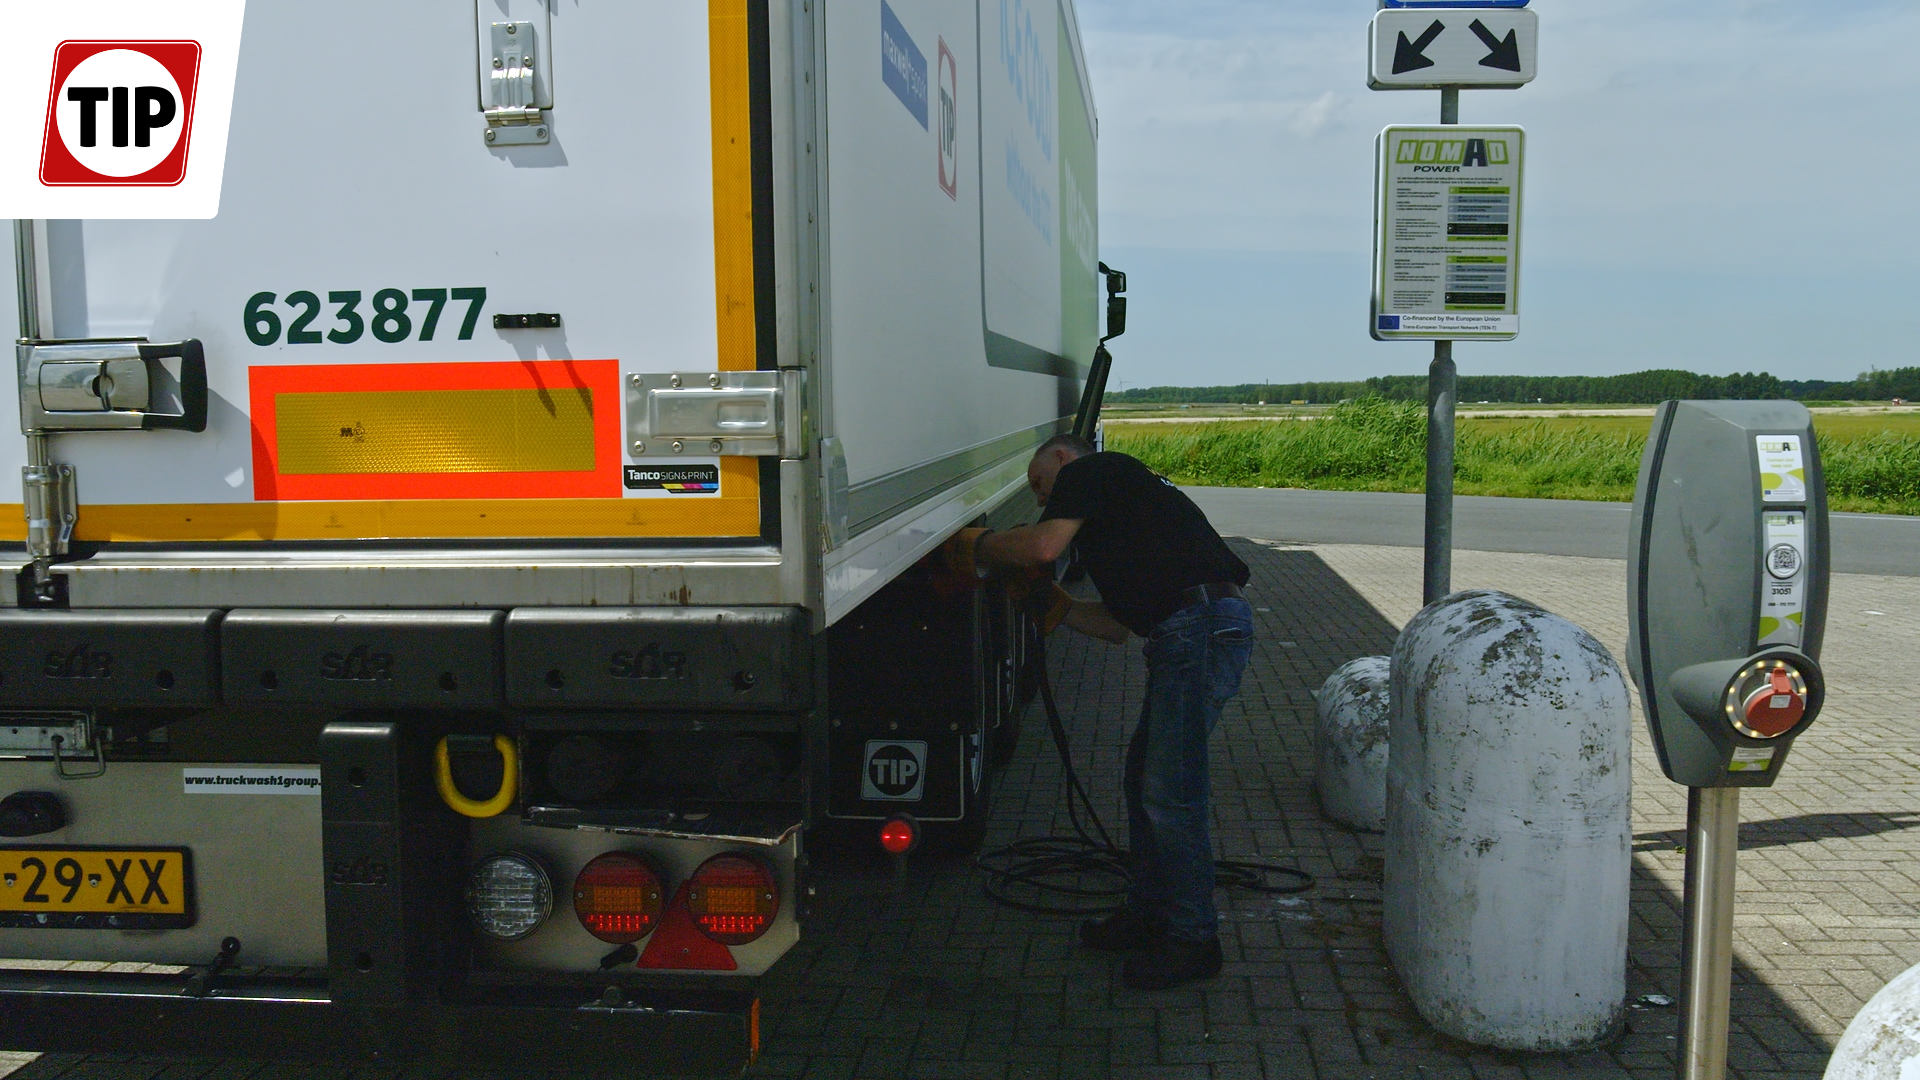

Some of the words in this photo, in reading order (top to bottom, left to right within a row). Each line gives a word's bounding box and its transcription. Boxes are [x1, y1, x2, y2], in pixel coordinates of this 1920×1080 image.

[941, 86, 955, 160] TIP
[1396, 139, 1509, 166] NOMAD
[244, 287, 487, 346] 623877
[627, 469, 660, 480] Tanco
[872, 759, 917, 785] TIP
